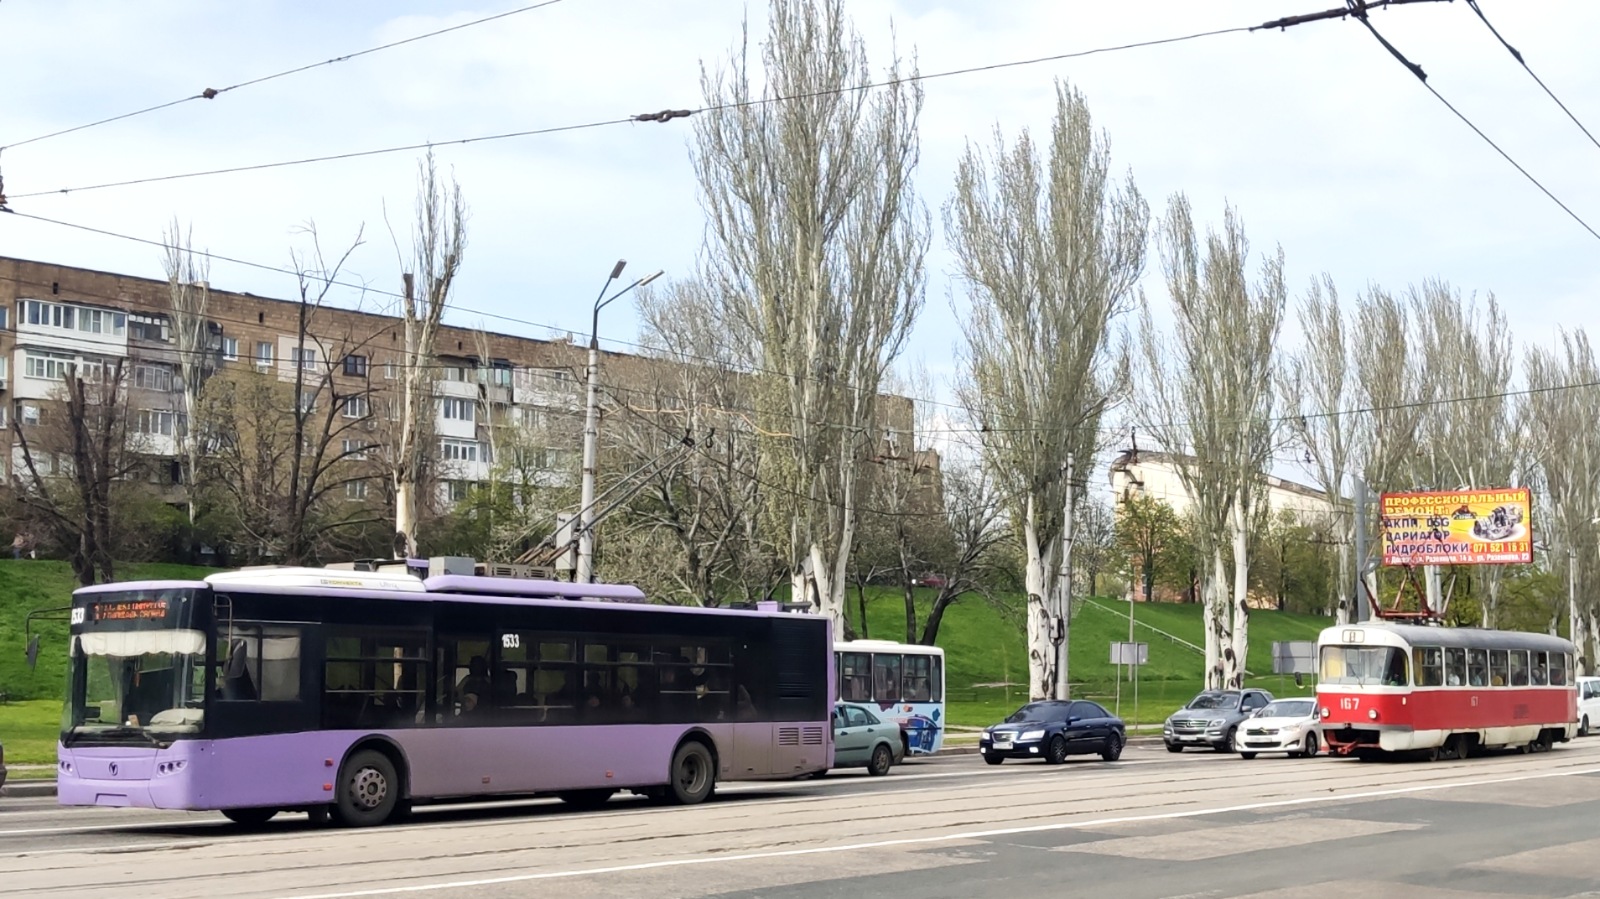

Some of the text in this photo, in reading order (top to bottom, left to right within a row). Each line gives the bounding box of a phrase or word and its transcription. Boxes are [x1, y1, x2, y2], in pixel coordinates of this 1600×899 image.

[1385, 492, 1527, 506] ПРОФЕССИОНАЛЬНЫЙ
[1386, 531, 1450, 541] ВАРИАТОР
[1386, 543, 1469, 555] ГИДРОБЛОКИ
[1473, 543, 1487, 553] 071
[1490, 543, 1504, 552] 521
[1519, 542, 1528, 551] 31
[501, 633, 520, 648] 1533
[1340, 697, 1360, 711] 167
